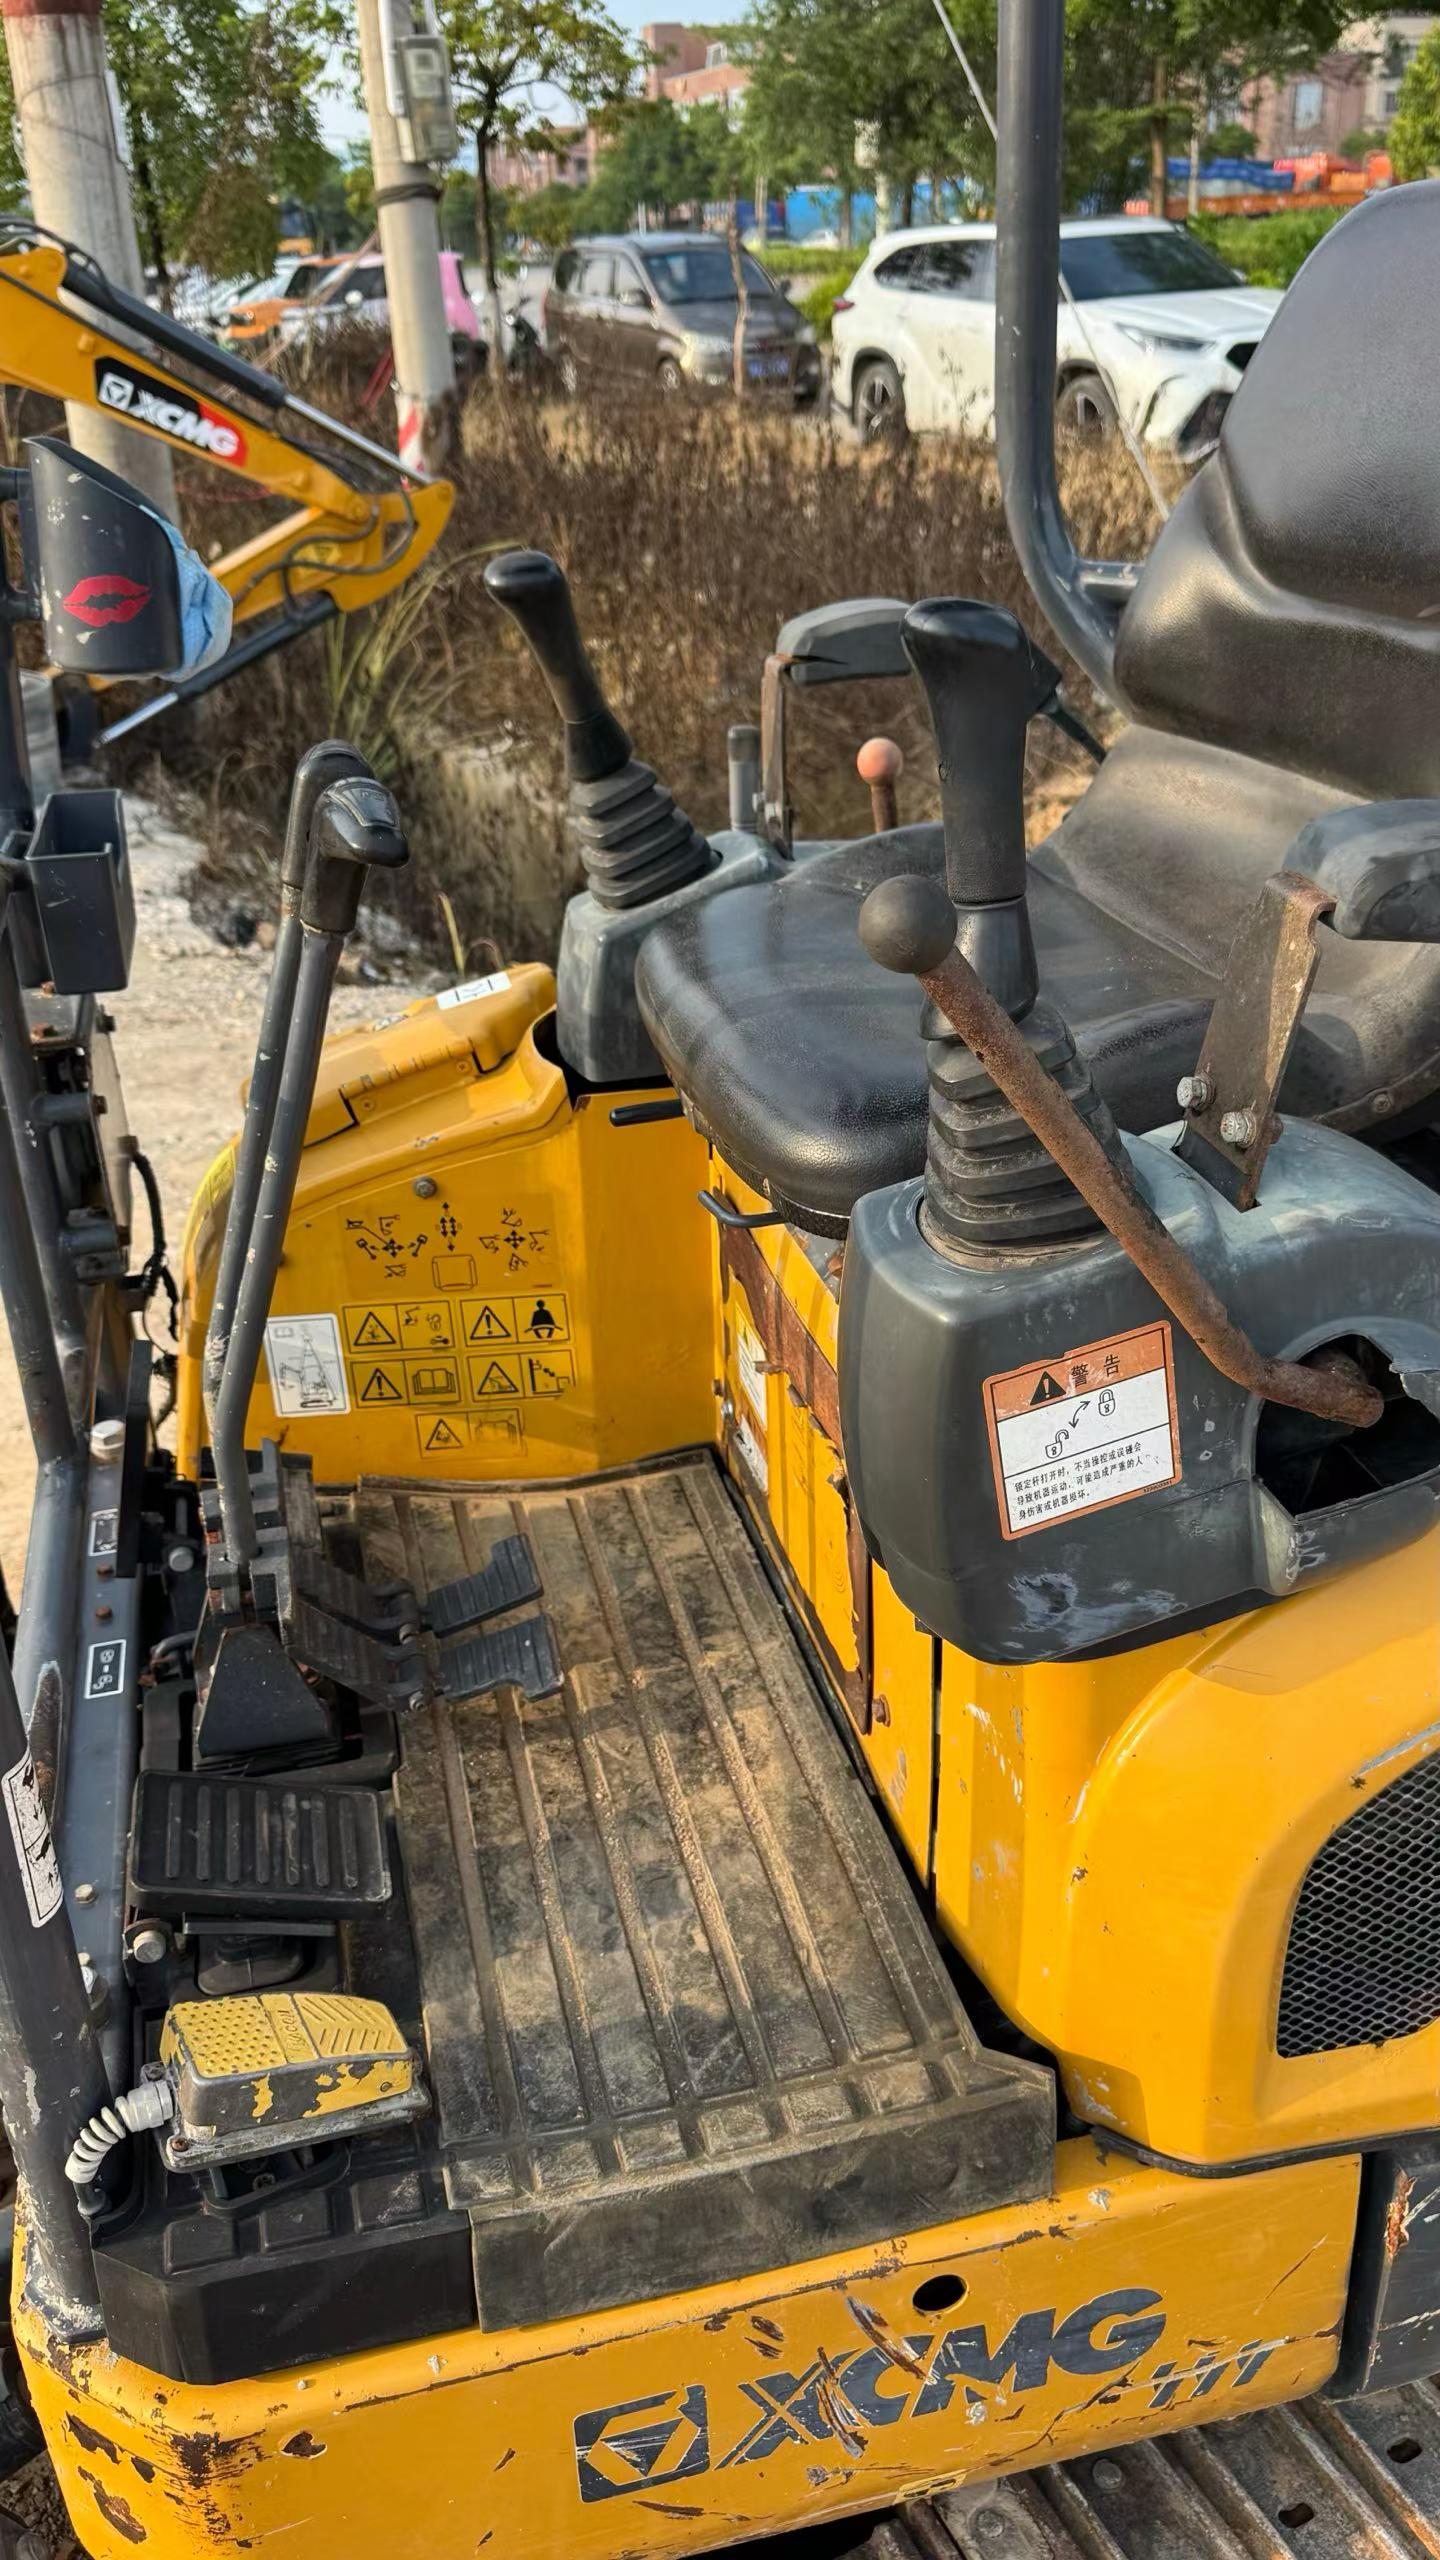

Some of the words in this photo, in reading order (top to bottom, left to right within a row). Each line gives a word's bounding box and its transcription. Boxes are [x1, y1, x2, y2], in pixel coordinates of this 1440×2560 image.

[127, 389, 240, 457] XCMG
[1070, 1354, 1120, 1387] 警告
[714, 2287, 1167, 2471] XCMG
